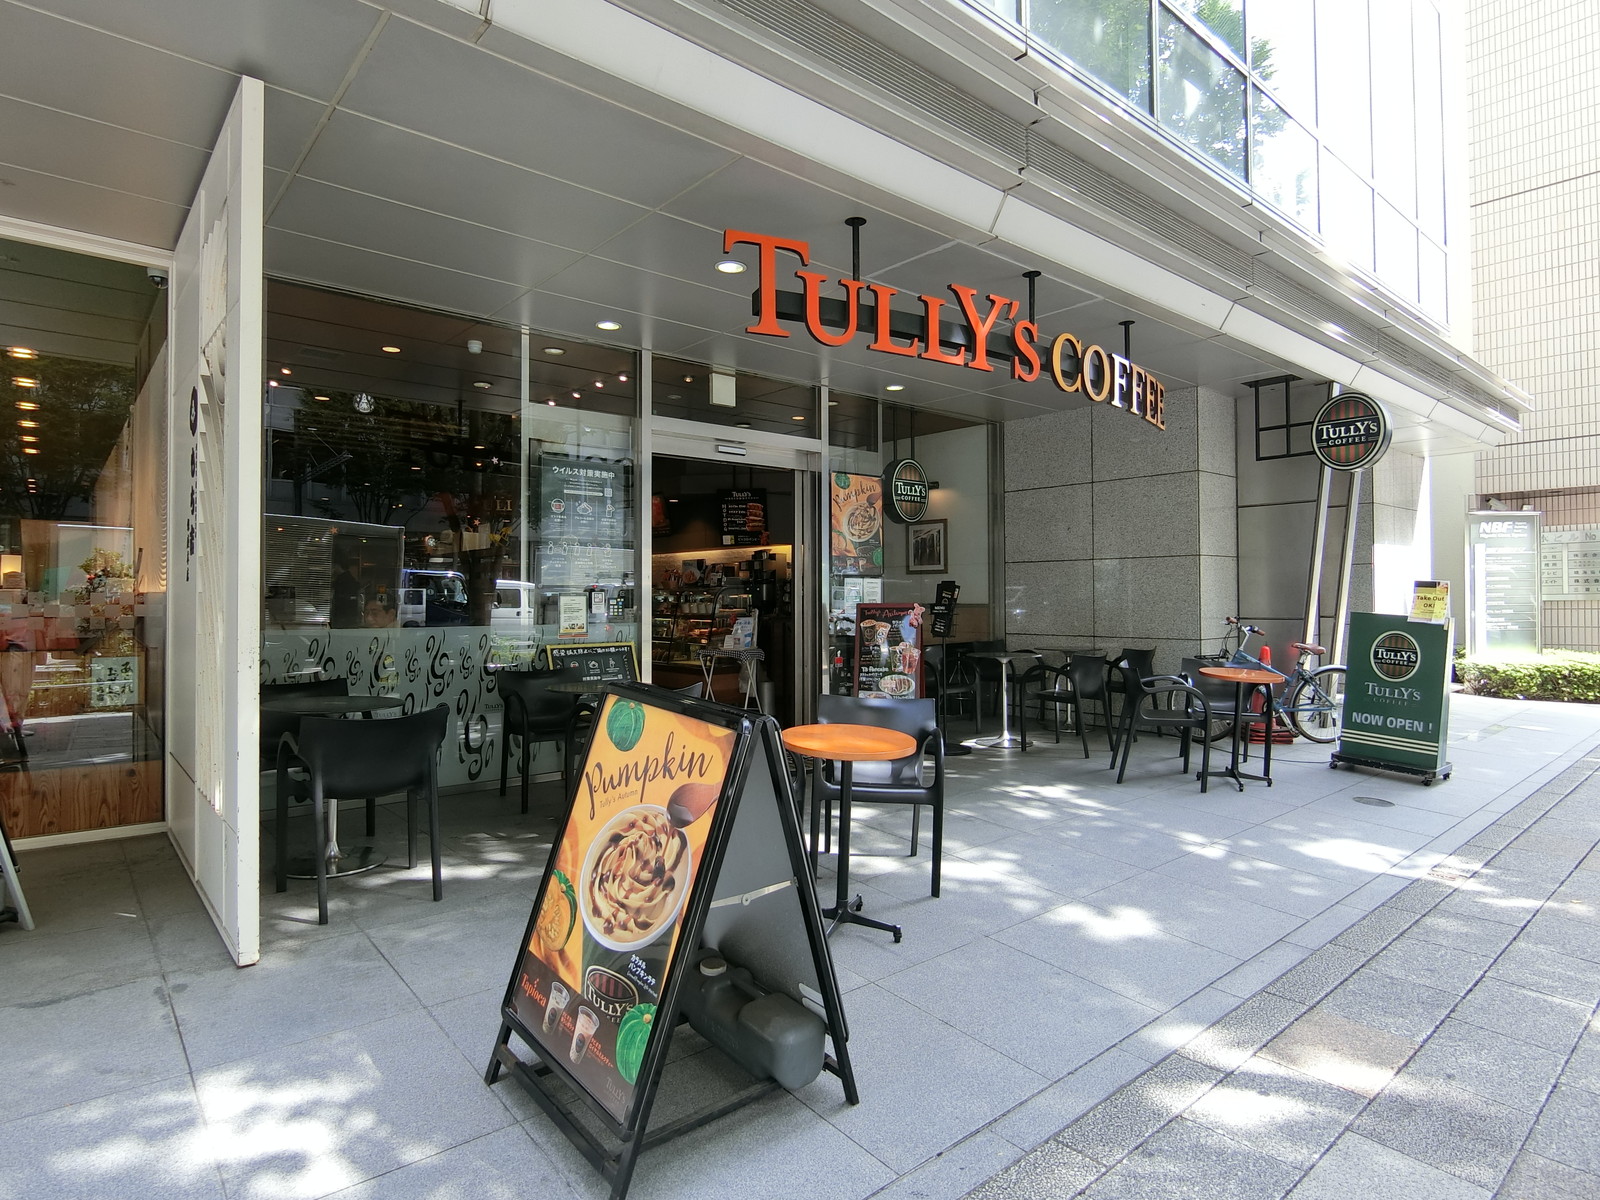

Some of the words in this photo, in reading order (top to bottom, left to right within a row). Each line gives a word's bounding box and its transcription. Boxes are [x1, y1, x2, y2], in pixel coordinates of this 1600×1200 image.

[724, 229, 1040, 382] TULLY'S
[1051, 333, 1166, 431] COFFEE
[1318, 421, 1378, 440] TULLY'S
[1328, 436, 1367, 446] COFFEE
[896, 481, 926, 497] TULLY'S
[1479, 521, 1513, 534] NBF
[1376, 648, 1416, 662] TULLY'S
[1365, 682, 1421, 701] TULLY'S
[1352, 711, 1384, 726] NOW
[1386, 716, 1423, 732] OPEN
[585, 731, 713, 821] Pumpkin
[521, 973, 547, 1007] Tapioca
